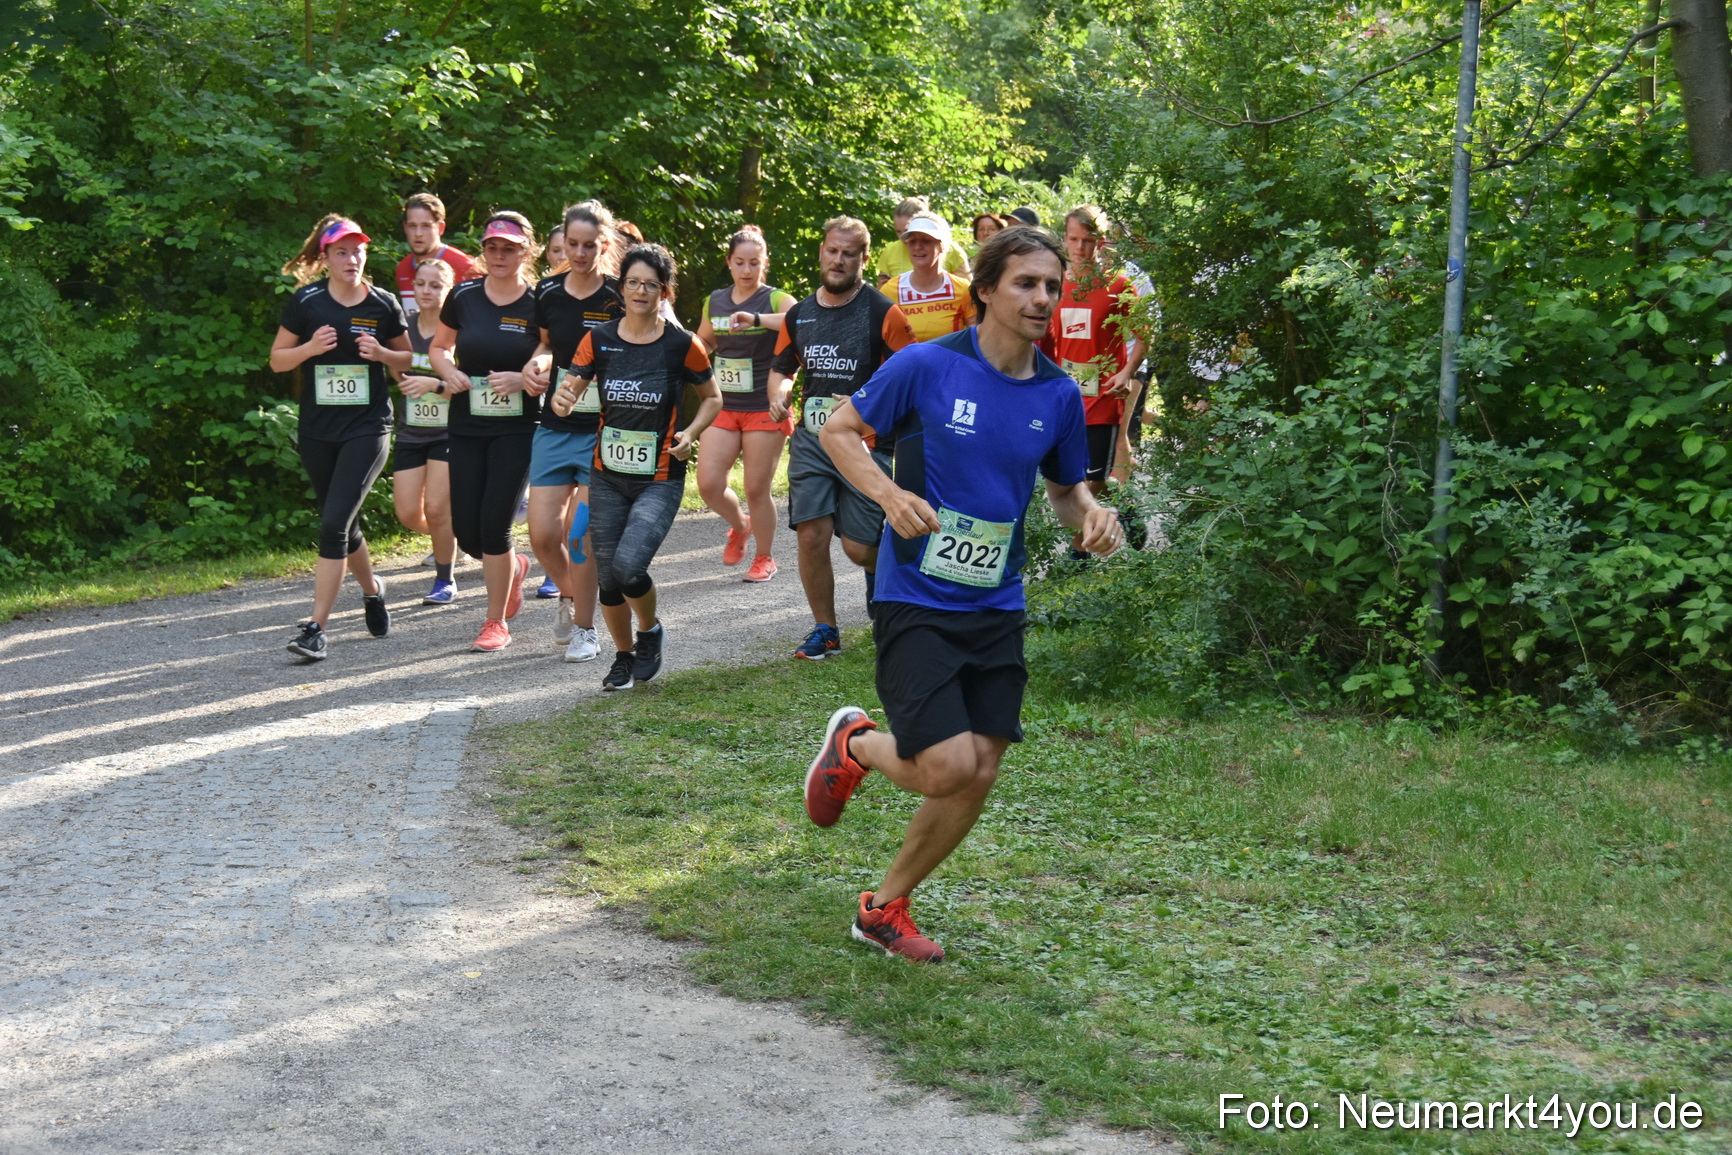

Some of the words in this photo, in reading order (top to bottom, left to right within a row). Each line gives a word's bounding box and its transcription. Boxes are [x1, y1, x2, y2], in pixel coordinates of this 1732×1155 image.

[901, 306, 923, 316] MAX
[927, 302, 956, 313] BÖGL
[803, 344, 839, 358] HECK
[807, 357, 858, 371] DESIGN
[720, 370, 741, 383] 331
[327, 379, 356, 394] 130
[604, 379, 642, 391] HECK
[481, 391, 511, 405] 124
[606, 391, 662, 403] DESIGN
[414, 403, 439, 417] 300
[607, 443, 648, 463] 1015
[936, 535, 1001, 569] 2022
[944, 561, 969, 573] Jascha
[970, 567, 990, 576] Lieske
